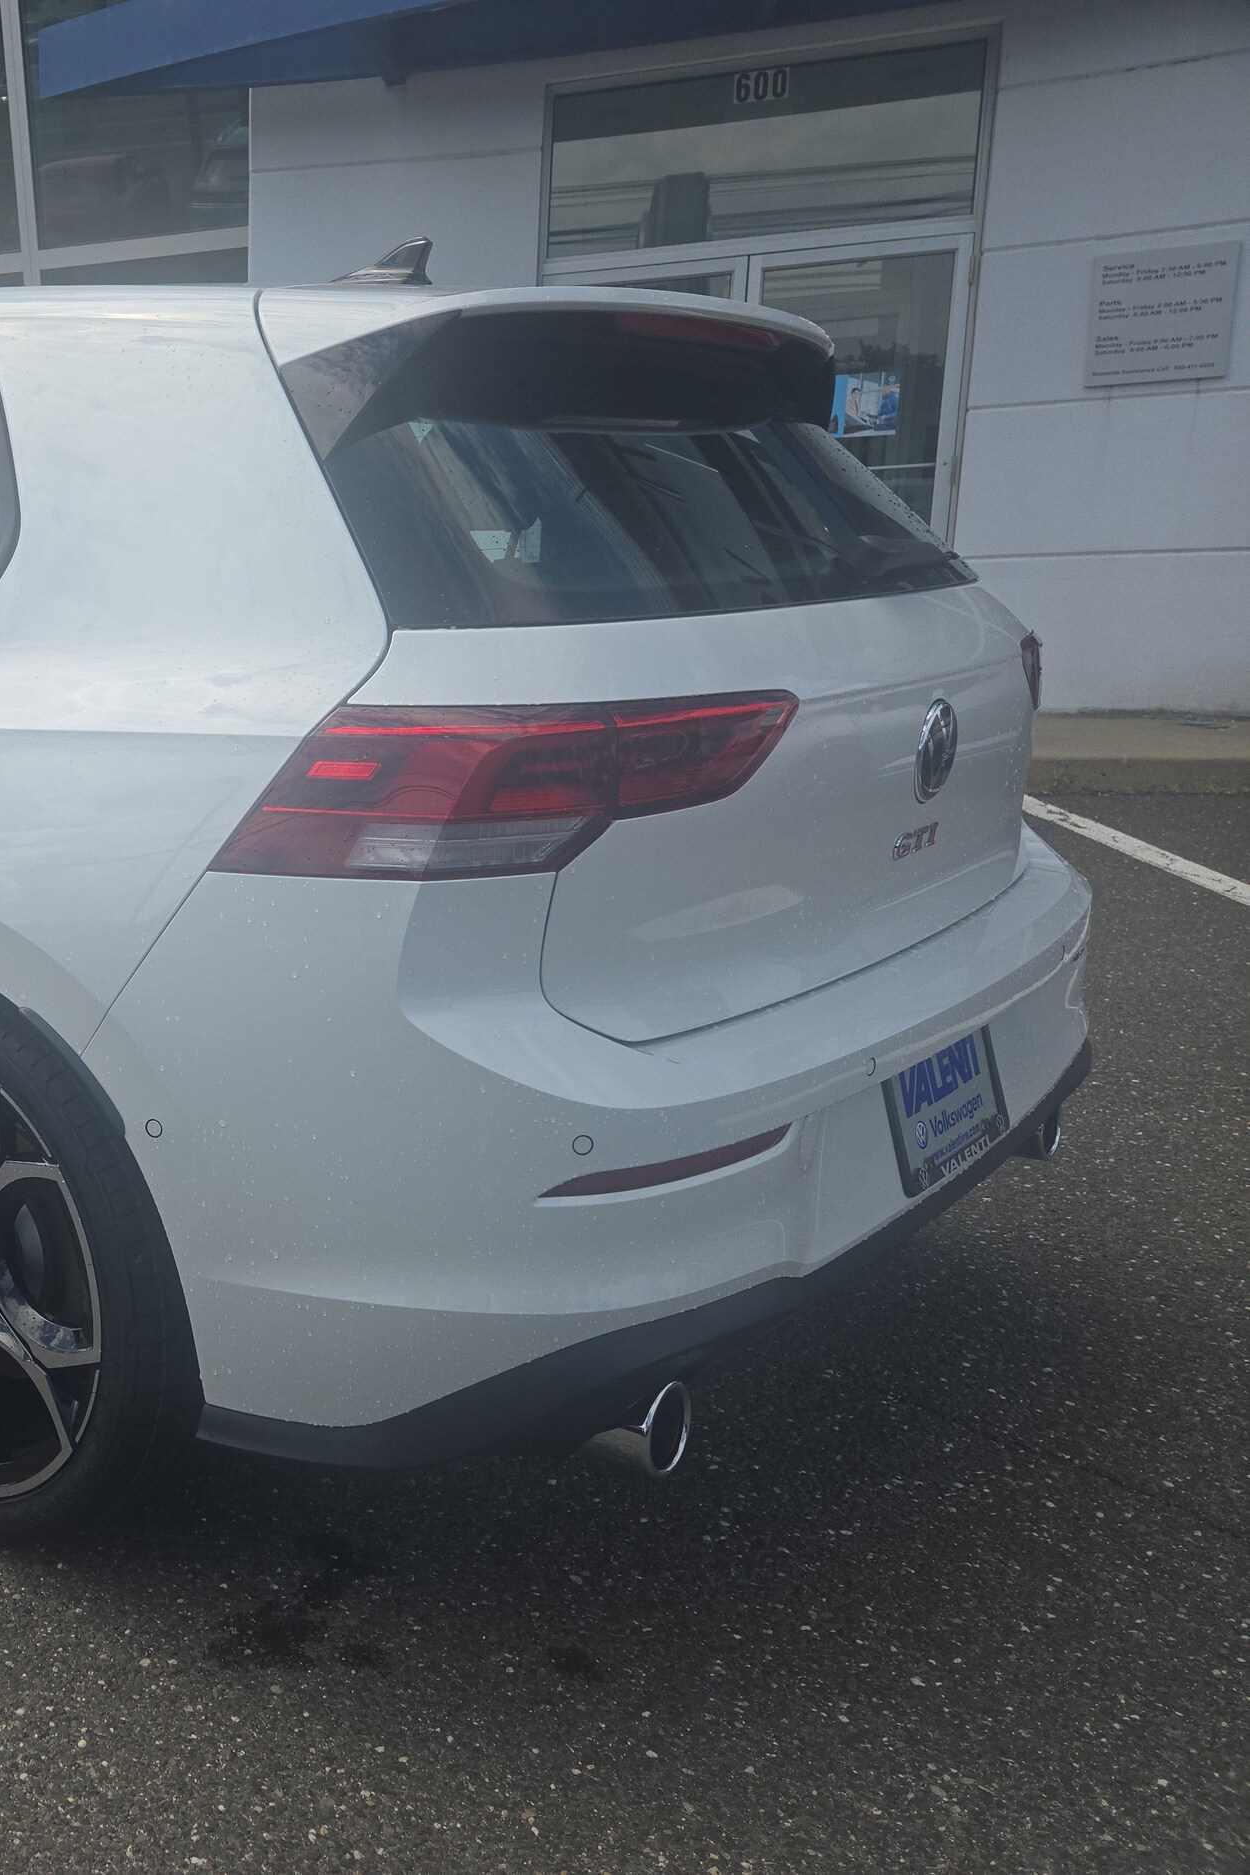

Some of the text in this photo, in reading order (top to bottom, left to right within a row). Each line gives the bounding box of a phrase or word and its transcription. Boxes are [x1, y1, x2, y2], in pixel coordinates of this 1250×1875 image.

[735, 67, 787, 103] 600
[893, 821, 939, 860] GTI
[899, 1034, 981, 1119] VALENTI
[929, 1093, 983, 1138] Volkswagen
[940, 1134, 991, 1177] VALENTI
